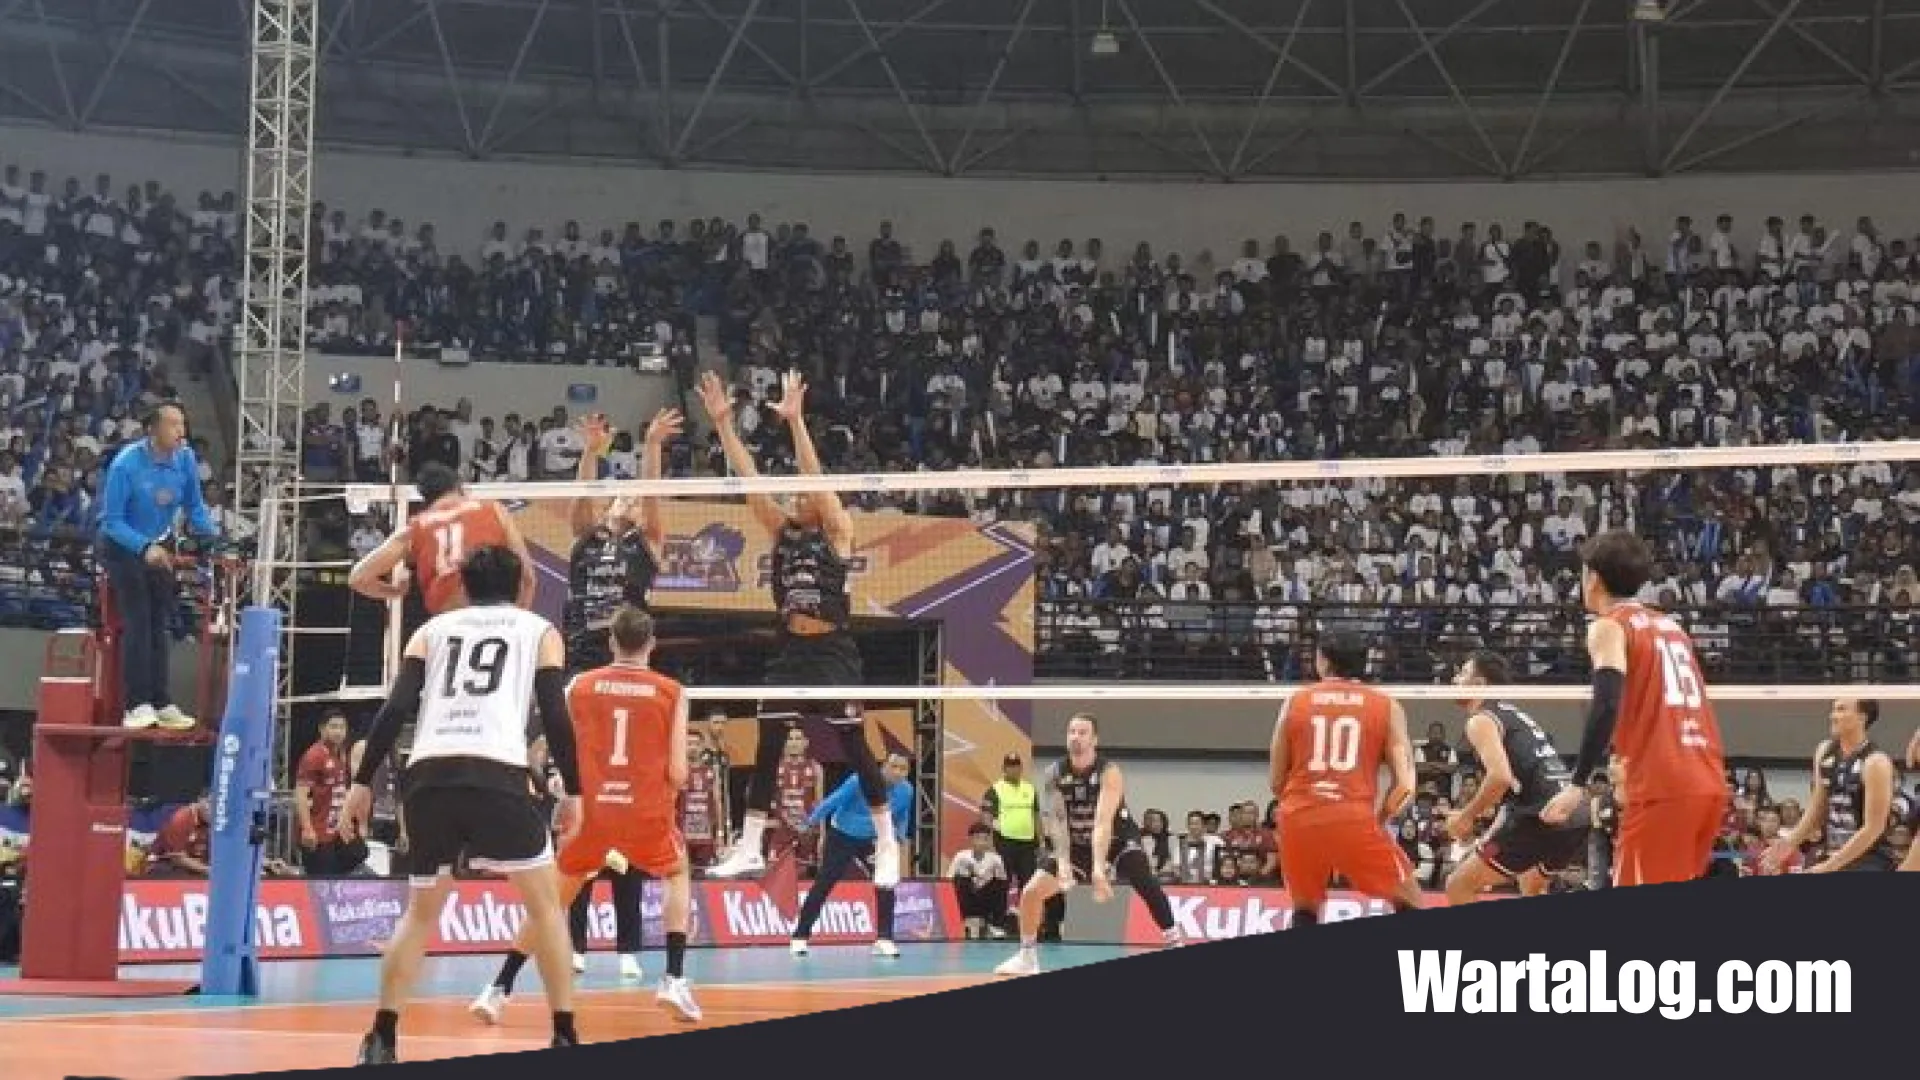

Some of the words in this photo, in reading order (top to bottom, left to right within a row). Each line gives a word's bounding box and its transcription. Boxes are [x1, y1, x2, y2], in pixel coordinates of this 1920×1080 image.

[441, 636, 509, 697] 19
[609, 708, 629, 766] 1
[1308, 714, 1361, 771] 10
